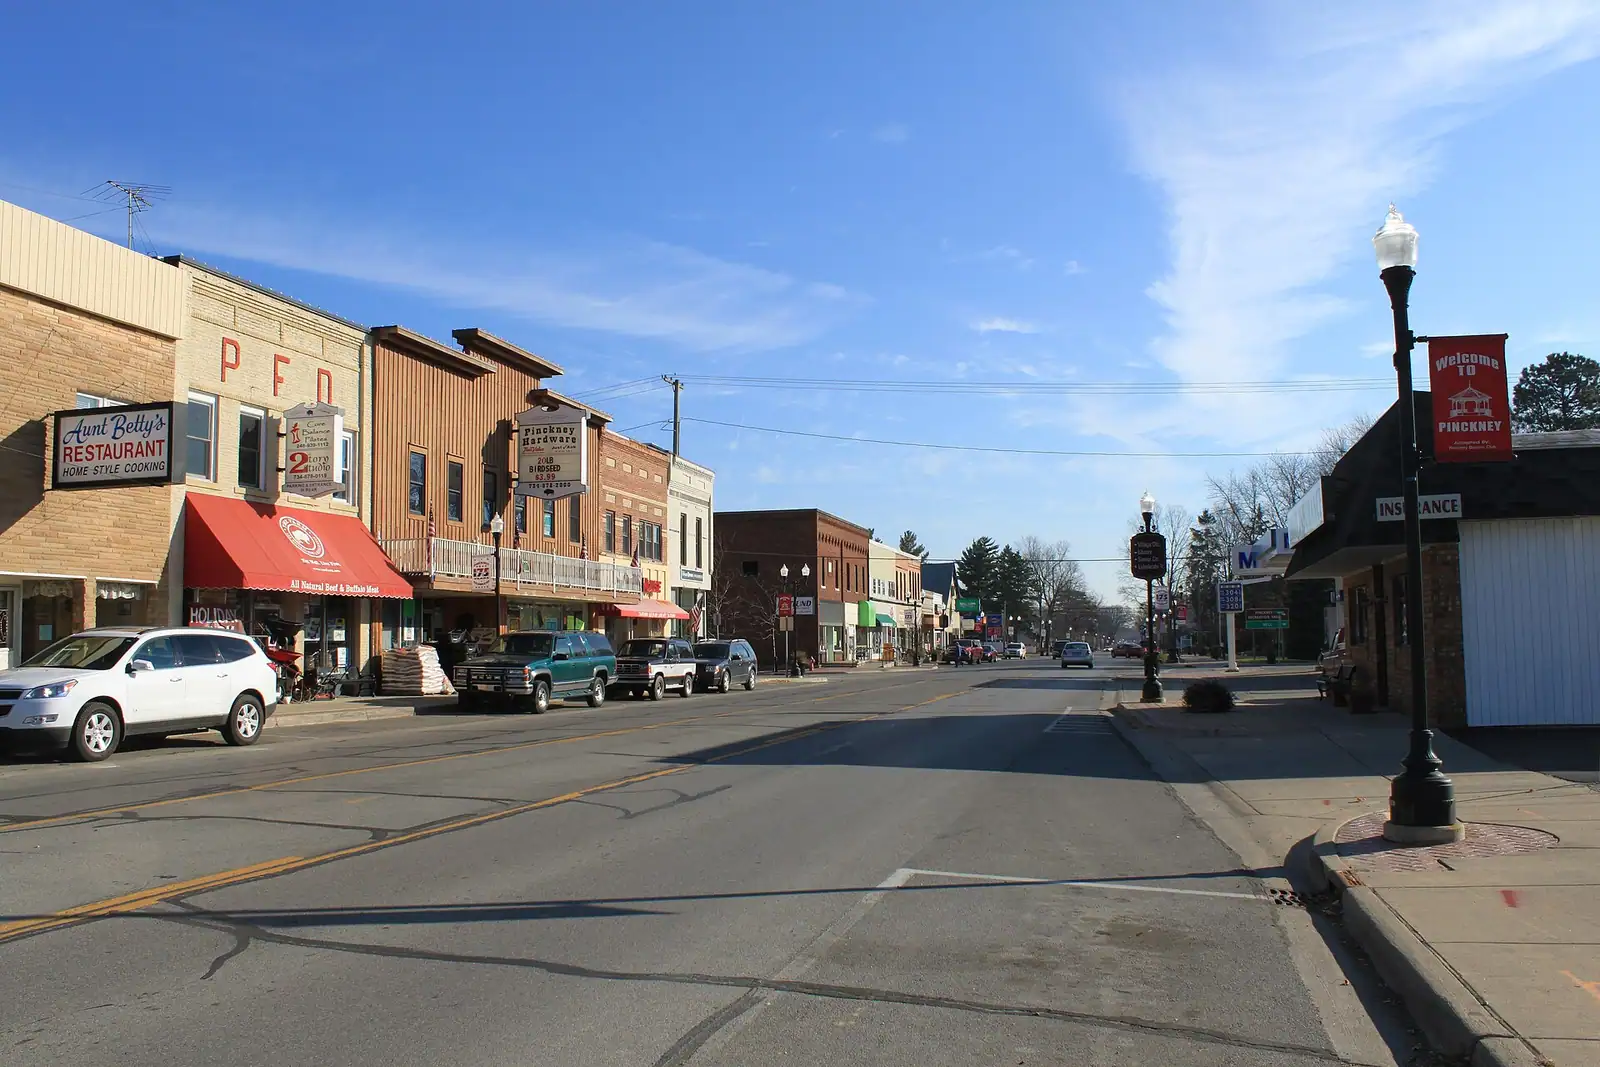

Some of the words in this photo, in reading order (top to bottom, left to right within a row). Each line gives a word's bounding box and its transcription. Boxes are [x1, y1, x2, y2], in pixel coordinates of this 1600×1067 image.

[1435, 352, 1500, 372] Welcome
[1456, 364, 1476, 376] TO
[62, 417, 109, 445] Aunt
[110, 413, 166, 441] Betty's
[306, 420, 326, 429] Core
[524, 425, 575, 437] Pinckney
[1438, 420, 1502, 433] PINCKNEY
[302, 428, 331, 436] Balance
[522, 435, 577, 447] Hardware
[63, 439, 165, 463] RESTAURANT
[62, 466, 89, 477] HOME
[93, 464, 120, 475] STYLE
[124, 461, 165, 473] COOKING
[529, 464, 561, 474] BIRDSEED
[535, 472, 556, 481] $3.99
[1379, 499, 1458, 517] INSANCE
[290, 579, 300, 588] All
[301, 580, 324, 591] Natural
[325, 583, 338, 592] Beef
[339, 584, 344, 592] &
[345, 585, 365, 593] Buffalo
[366, 586, 379, 594] Meat
[190, 606, 238, 624] HOLIDAY
